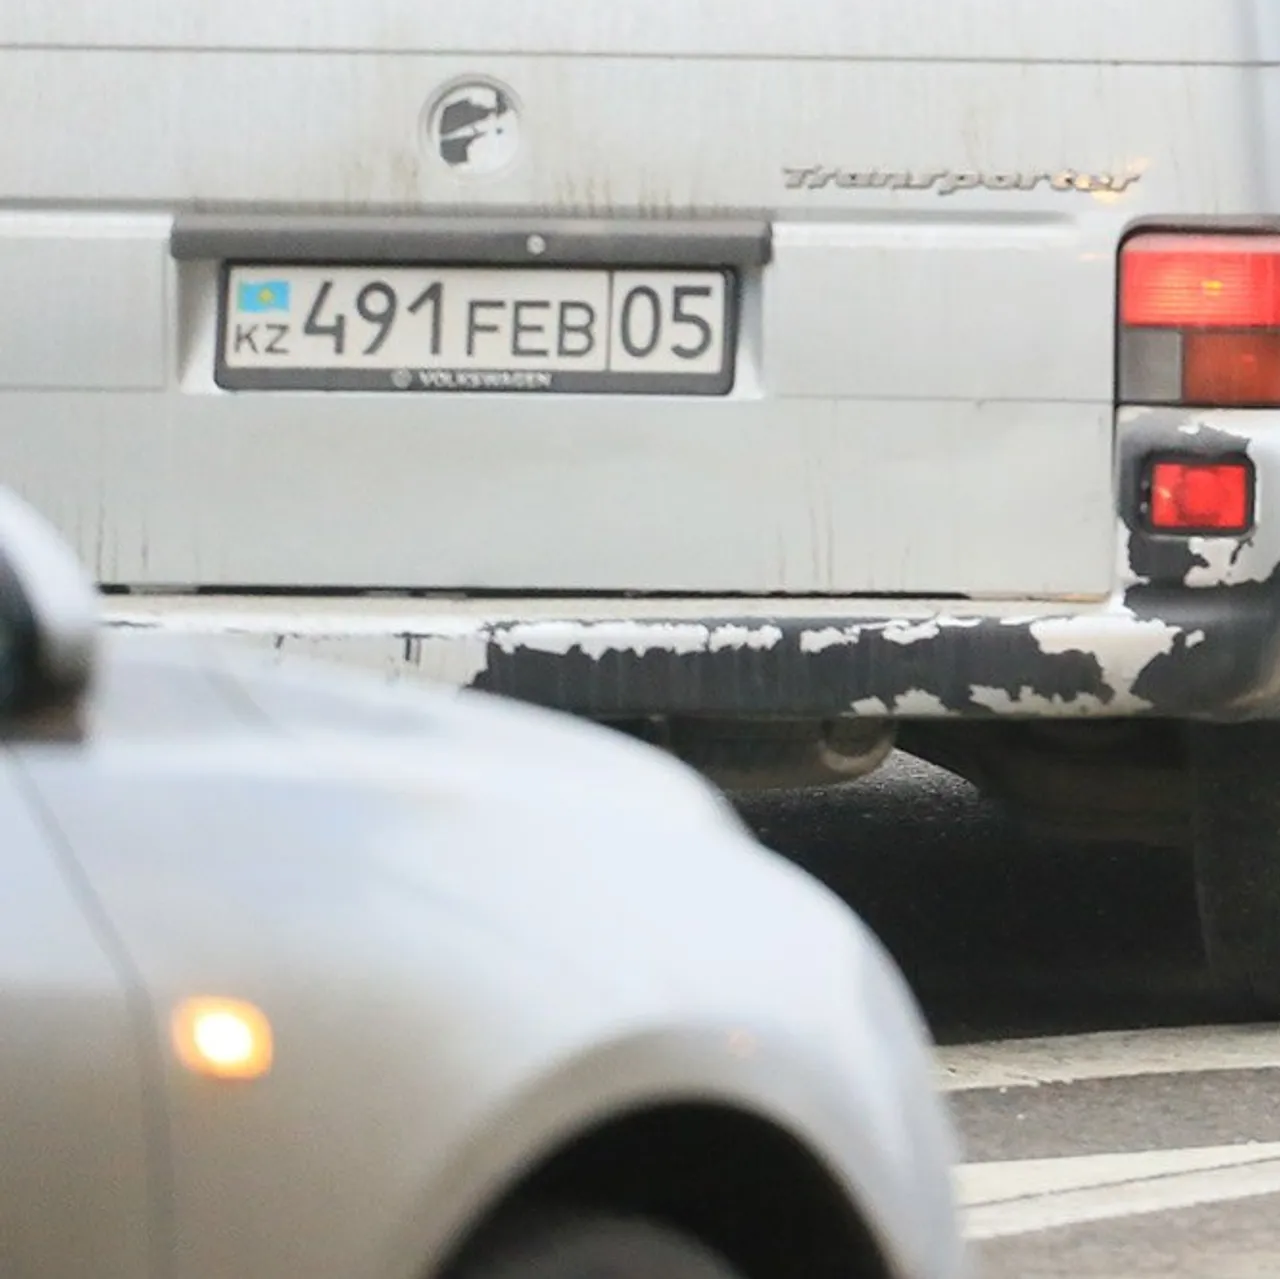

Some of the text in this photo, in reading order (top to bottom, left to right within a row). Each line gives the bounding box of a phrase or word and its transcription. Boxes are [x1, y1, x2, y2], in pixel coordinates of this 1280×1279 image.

[619, 283, 714, 361] 05
[233, 323, 291, 355] KZ
[418, 370, 553, 389] VOLKSWAGEN
